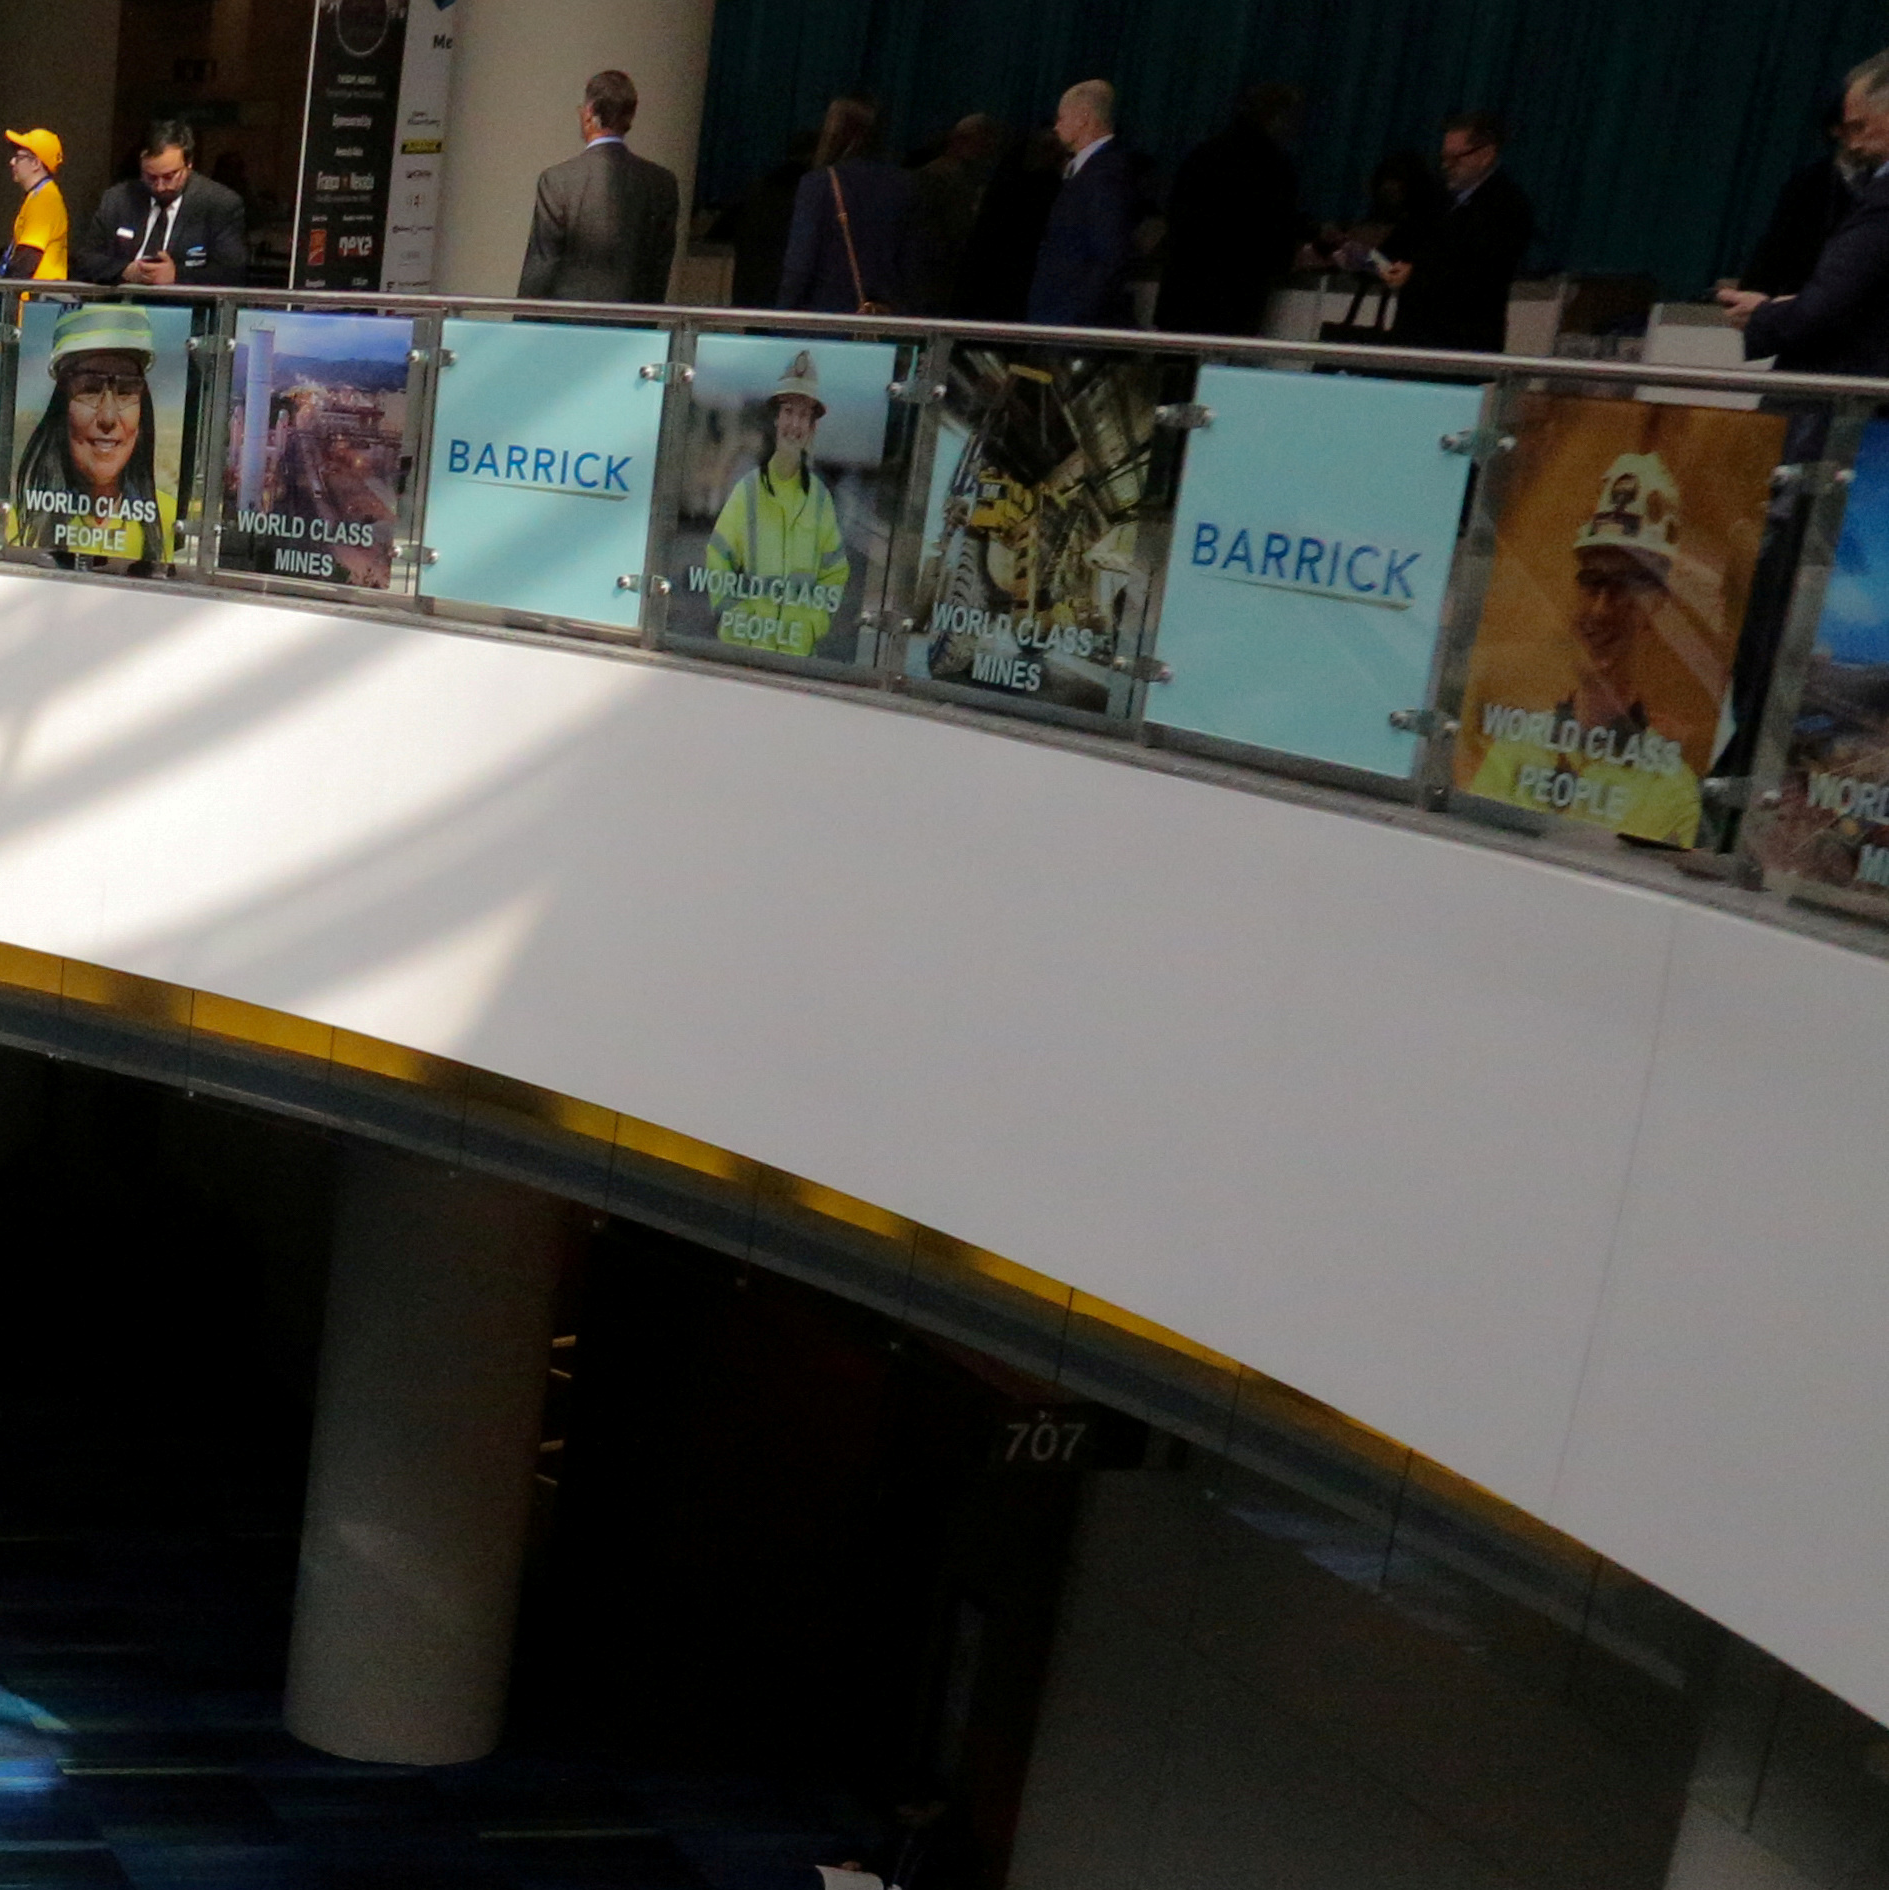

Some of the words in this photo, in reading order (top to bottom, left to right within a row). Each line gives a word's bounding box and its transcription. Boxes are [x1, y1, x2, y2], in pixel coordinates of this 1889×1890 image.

[448, 439, 633, 492] BARRICK
[25, 489, 91, 516] WORLD
[95, 497, 156, 523] CLASS
[54, 523, 127, 552] PEOPLE
[237, 510, 304, 539] WORLD
[309, 521, 374, 547] CLASS
[275, 548, 334, 577] MINES
[1191, 521, 1421, 598] BARRICK
[687, 565, 764, 601] WORLD
[770, 576, 842, 614] CLASS
[720, 610, 803, 647] PEOPLE
[931, 601, 1013, 639] WORLD
[1018, 617, 1094, 656] CLASS
[972, 653, 1042, 691] MINES
[1482, 703, 1581, 754] WORLD
[1585, 725, 1683, 778] CLASS
[1517, 764, 1632, 820] PEOPLE
[1806, 771, 1889, 825] WORL
[1005, 1422, 1087, 1462] 707
